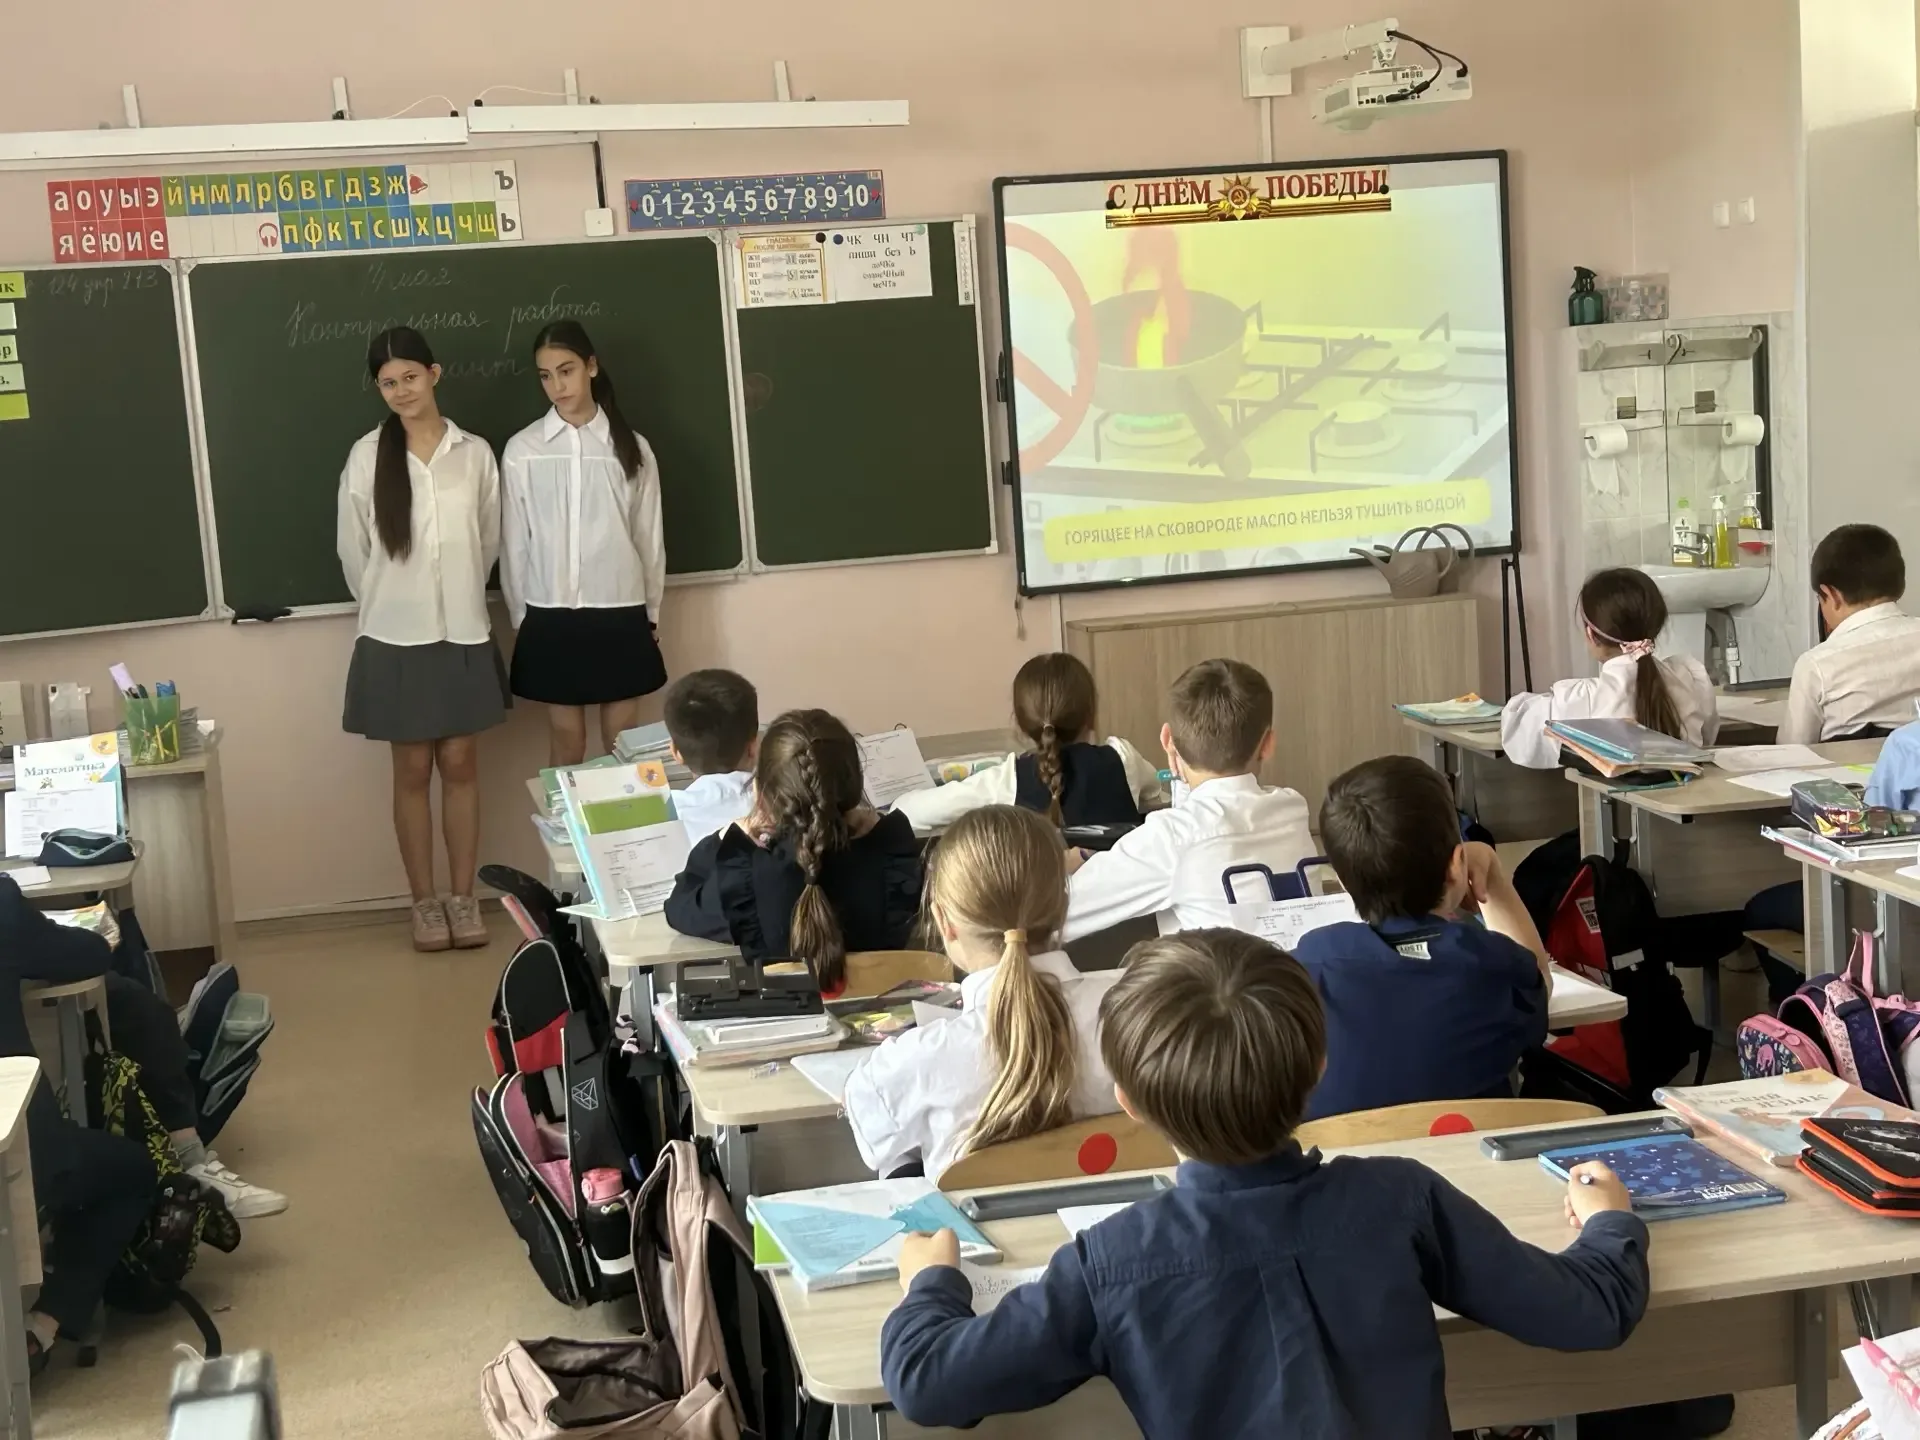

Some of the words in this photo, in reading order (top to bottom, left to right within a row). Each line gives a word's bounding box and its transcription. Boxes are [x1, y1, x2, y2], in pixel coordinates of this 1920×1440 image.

[642, 194, 655, 217] 0
[662, 193, 673, 215] 1
[681, 192, 695, 215] 2
[703, 191, 716, 214] 3
[723, 190, 737, 213] 4
[744, 190, 757, 212] 5
[764, 189, 778, 211] 6
[784, 188, 797, 210] 7
[804, 187, 817, 210] 8
[824, 186, 838, 208] 9
[844, 184, 869, 207] 10
[1133, 177, 1212, 213] ДНЁМ
[1265, 169, 1387, 201] ПОБЕДЫ!
[847, 235, 862, 245] ЧК
[873, 233, 889, 243] ЧН
[901, 231, 917, 241] ЧТ
[848, 250, 876, 259] пиши
[884, 246, 901, 256] без
[1065, 526, 1130, 545] ГОРЯЩЕЕ
[1134, 525, 1154, 539] НА
[1157, 516, 1243, 537] СКОВОРОДЕ
[1246, 511, 1297, 530] МАСЛО
[1301, 507, 1353, 525] НЕЛЬЗЯ
[1356, 501, 1411, 520] ТУШИТЬ
[1416, 493, 1466, 512] ВОДОЙ
[24, 761, 106, 778] Математика
